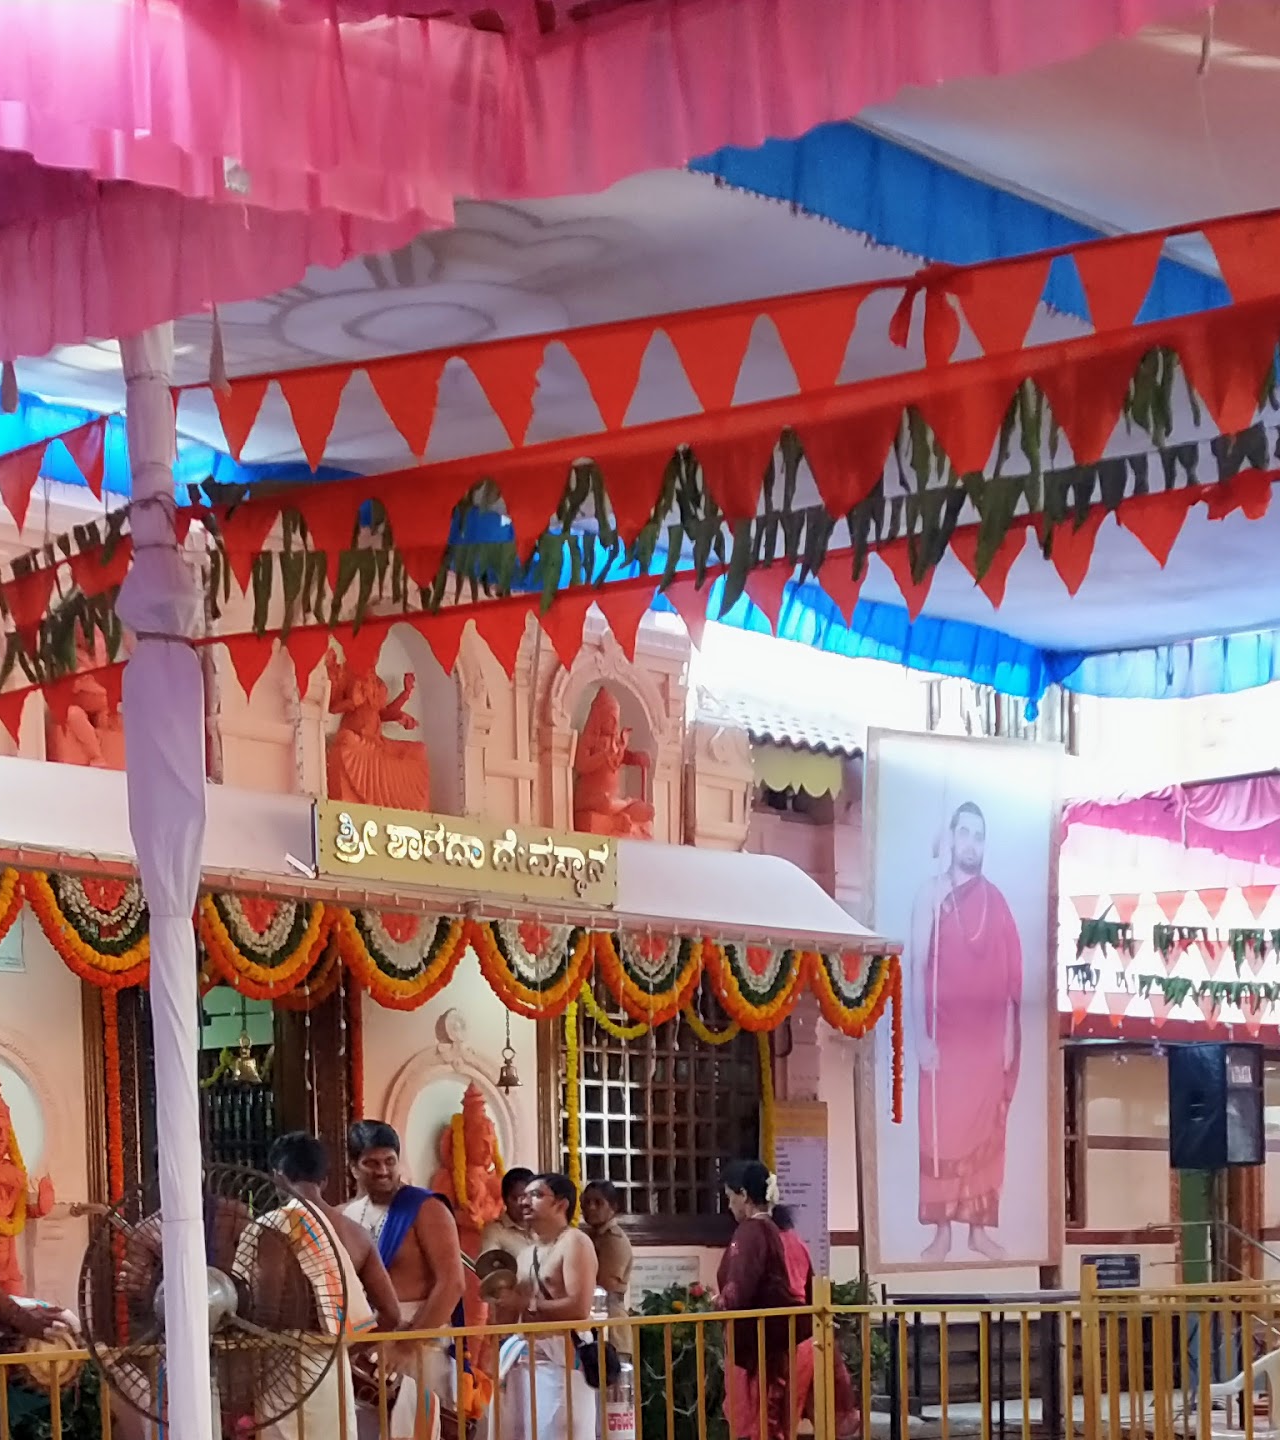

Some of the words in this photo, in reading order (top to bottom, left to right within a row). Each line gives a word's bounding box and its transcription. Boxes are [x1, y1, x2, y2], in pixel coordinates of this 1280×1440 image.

[335, 811, 379, 864] ಶ್ರೀ
[385, 823, 485, 869] ಶಾರದಾ
[492, 828, 610, 898] ದೇವಸ್ಥಾನ
